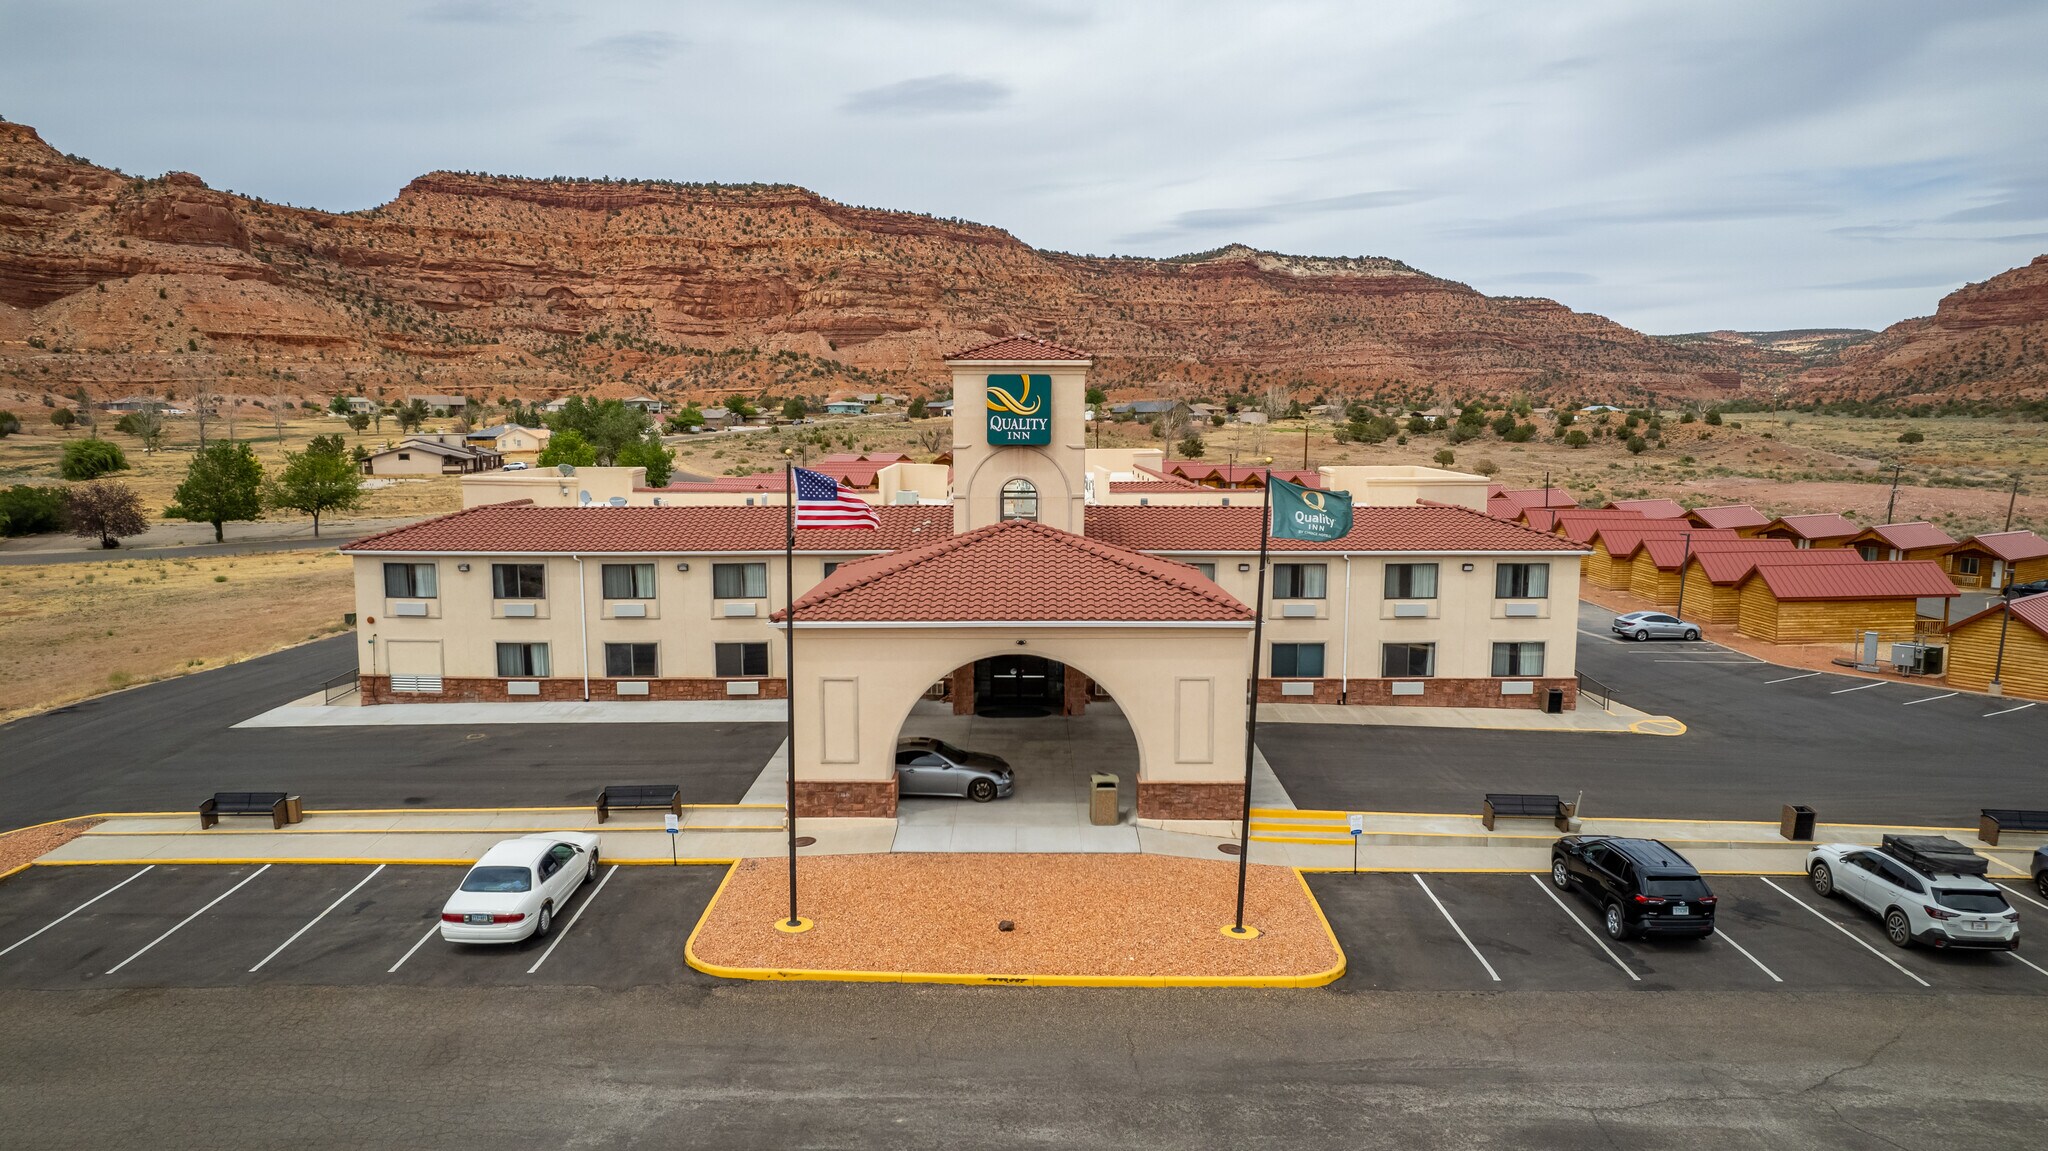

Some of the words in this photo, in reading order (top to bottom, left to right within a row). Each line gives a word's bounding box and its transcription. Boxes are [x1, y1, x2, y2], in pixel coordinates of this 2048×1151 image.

[1007, 431, 1030, 440] INN
[1295, 511, 1335, 528] Quality
[1308, 524, 1325, 532] INN
